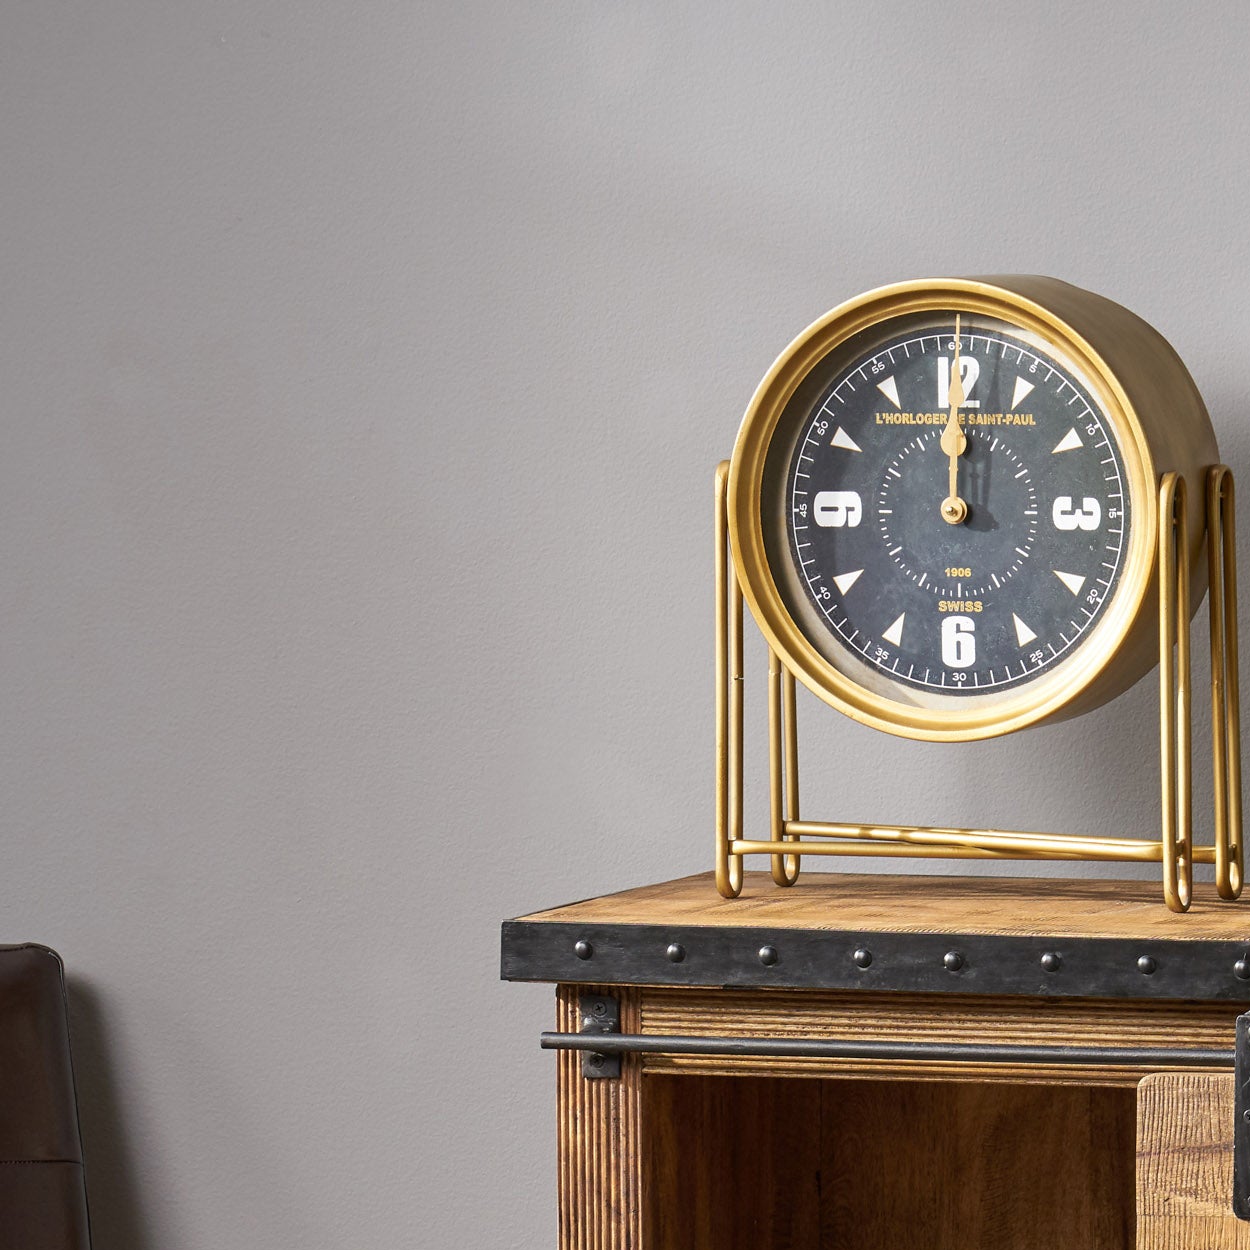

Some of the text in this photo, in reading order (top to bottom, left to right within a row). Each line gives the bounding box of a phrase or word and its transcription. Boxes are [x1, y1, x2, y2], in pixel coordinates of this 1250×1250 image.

[871, 361, 886, 374] 55
[1028, 363, 1038, 373] 5
[937, 355, 981, 409] 12
[875, 413, 949, 425] L'HORLOGER
[968, 413, 1036, 426] SAINT-PAUL
[817, 420, 829, 436] 50
[1085, 423, 1096, 436] 10
[799, 503, 808, 518] 45
[1052, 496, 1102, 531] 3
[1108, 507, 1117, 519] 15
[944, 567, 972, 578] 1906
[819, 586, 831, 600] 40
[1086, 588, 1099, 605] 20
[938, 600, 984, 612] SWISS
[941, 615, 976, 668] 6
[874, 647, 890, 660] 35
[1029, 649, 1044, 662] 25
[952, 672, 967, 681] 30
